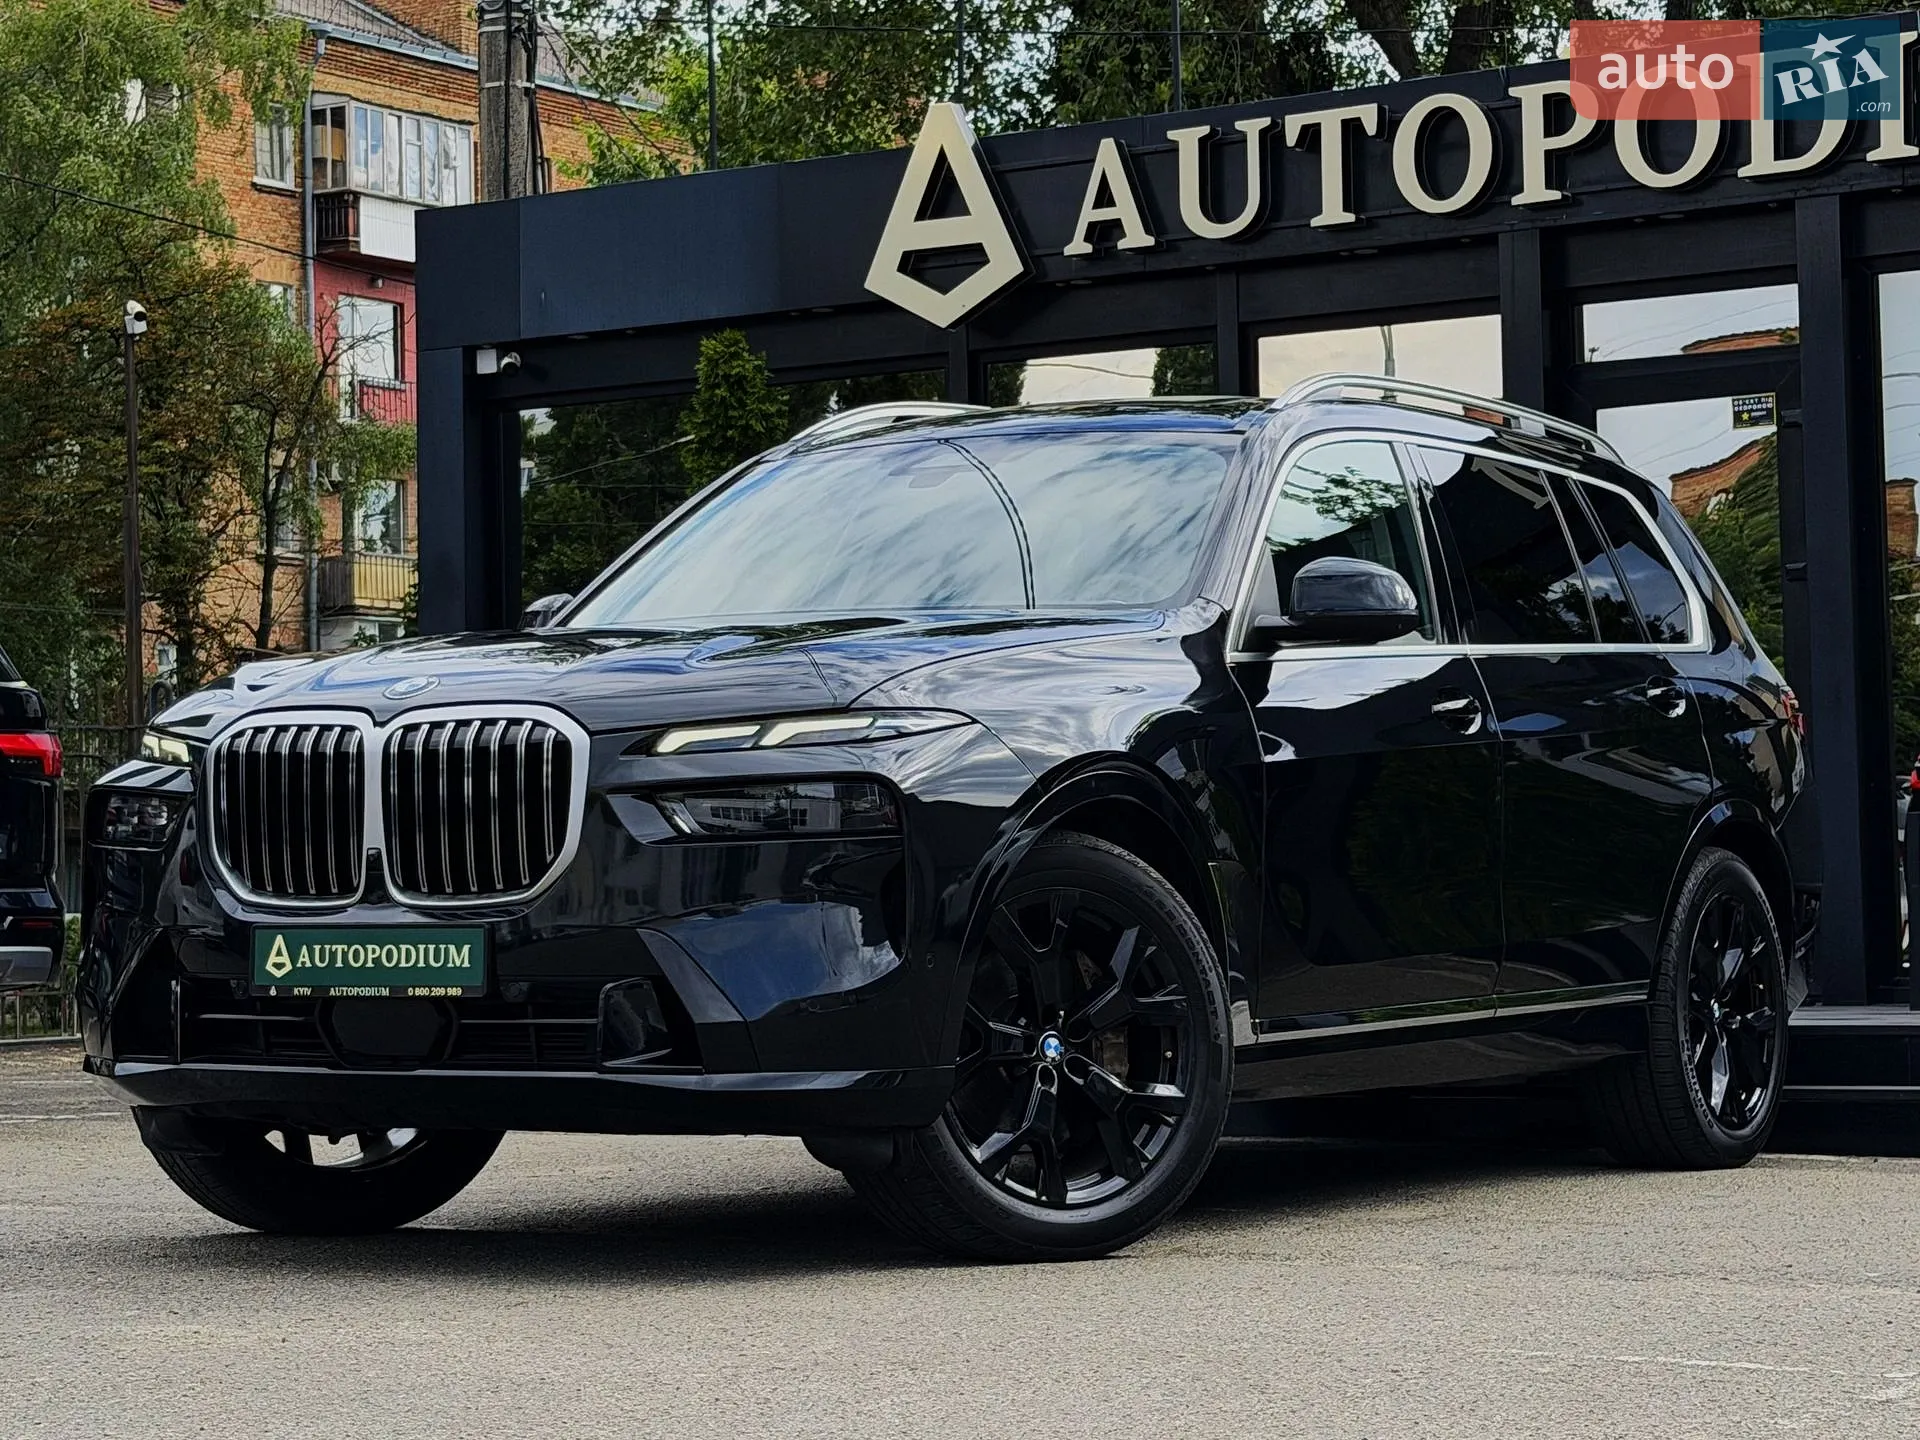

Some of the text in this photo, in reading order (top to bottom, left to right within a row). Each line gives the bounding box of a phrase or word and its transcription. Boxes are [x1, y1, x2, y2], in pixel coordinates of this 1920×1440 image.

[1063, 10, 1920, 258] AUTOPODI
[296, 944, 471, 968] AUTOPODIUM
[293, 987, 462, 997] KYIV AUTOPODIUM 0 800 209 989
